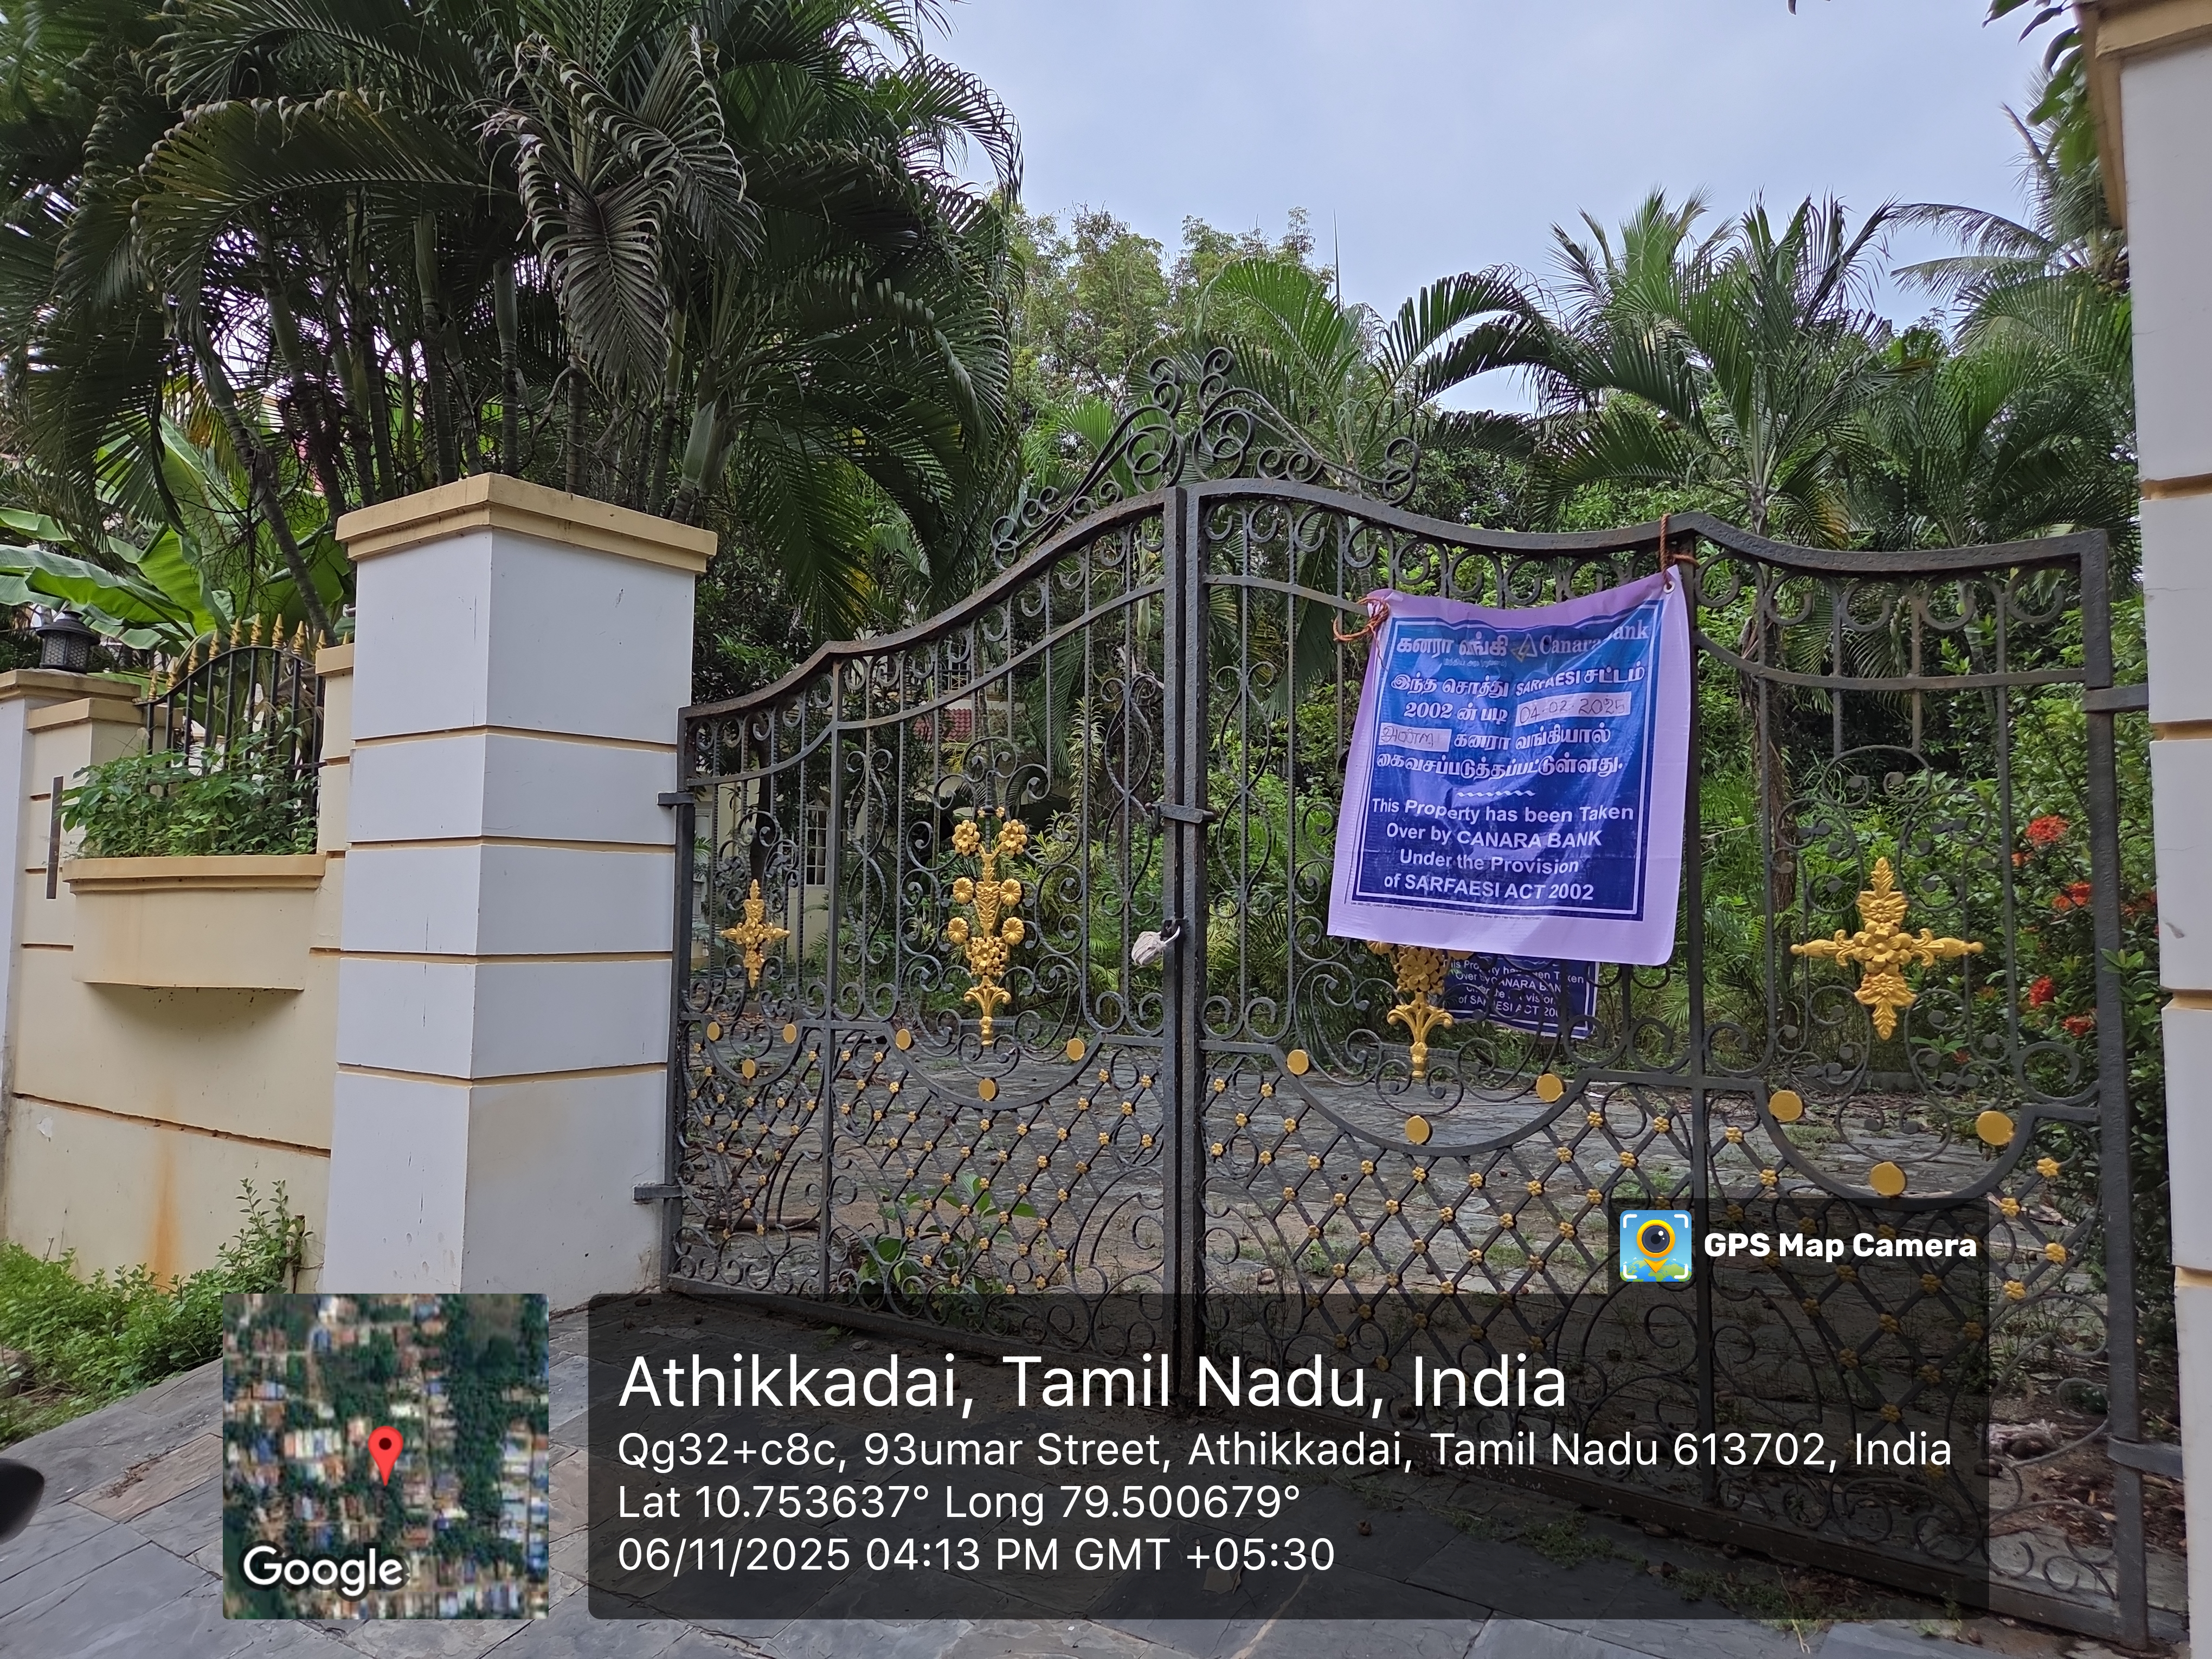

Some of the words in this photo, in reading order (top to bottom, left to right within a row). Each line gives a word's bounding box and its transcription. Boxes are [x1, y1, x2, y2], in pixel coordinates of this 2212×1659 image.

[1605, 619, 1649, 641] ank
[1397, 637, 1454, 659] கனரா
[1391, 672, 1437, 696] இந்த
[1442, 674, 1509, 698] சொத்து
[1584, 660, 1645, 684] சட்டம்
[1403, 702, 1454, 719] 2002
[1457, 702, 1478, 722] ன்
[1480, 707, 1509, 725] படி
[1454, 732, 1512, 751] கனரா
[1515, 721, 1611, 750] வங்கியால்
[1372, 798, 1400, 813] This
[1404, 799, 1481, 825] Property
[1486, 806, 1518, 822] has
[1525, 806, 1573, 822] been
[1579, 804, 1634, 821] Taken
[1386, 822, 1426, 840] Over
[1431, 825, 1452, 846] by
[1457, 831, 1541, 848] CANARA
[1547, 830, 1603, 848] BANK
[1399, 848, 1453, 867] Under
[1456, 854, 1484, 870] the
[1491, 856, 1579, 874] Provision
[1384, 873, 1402, 889] of
[1404, 873, 1500, 898] SARFAESI
[1504, 883, 1546, 899] ACT
[1548, 883, 1594, 901] 2002
[1463, 960, 1500, 976] Proty
[1503, 966, 1522, 975] ha
[1455, 973, 1477, 981] Over
[1479, 973, 1490, 985] by
[1539, 981, 1561, 993] BAN
[1458, 994, 1468, 1004] of
[1470, 995, 1513, 1012] SAESI
[1515, 1004, 1540, 1015] ACT
